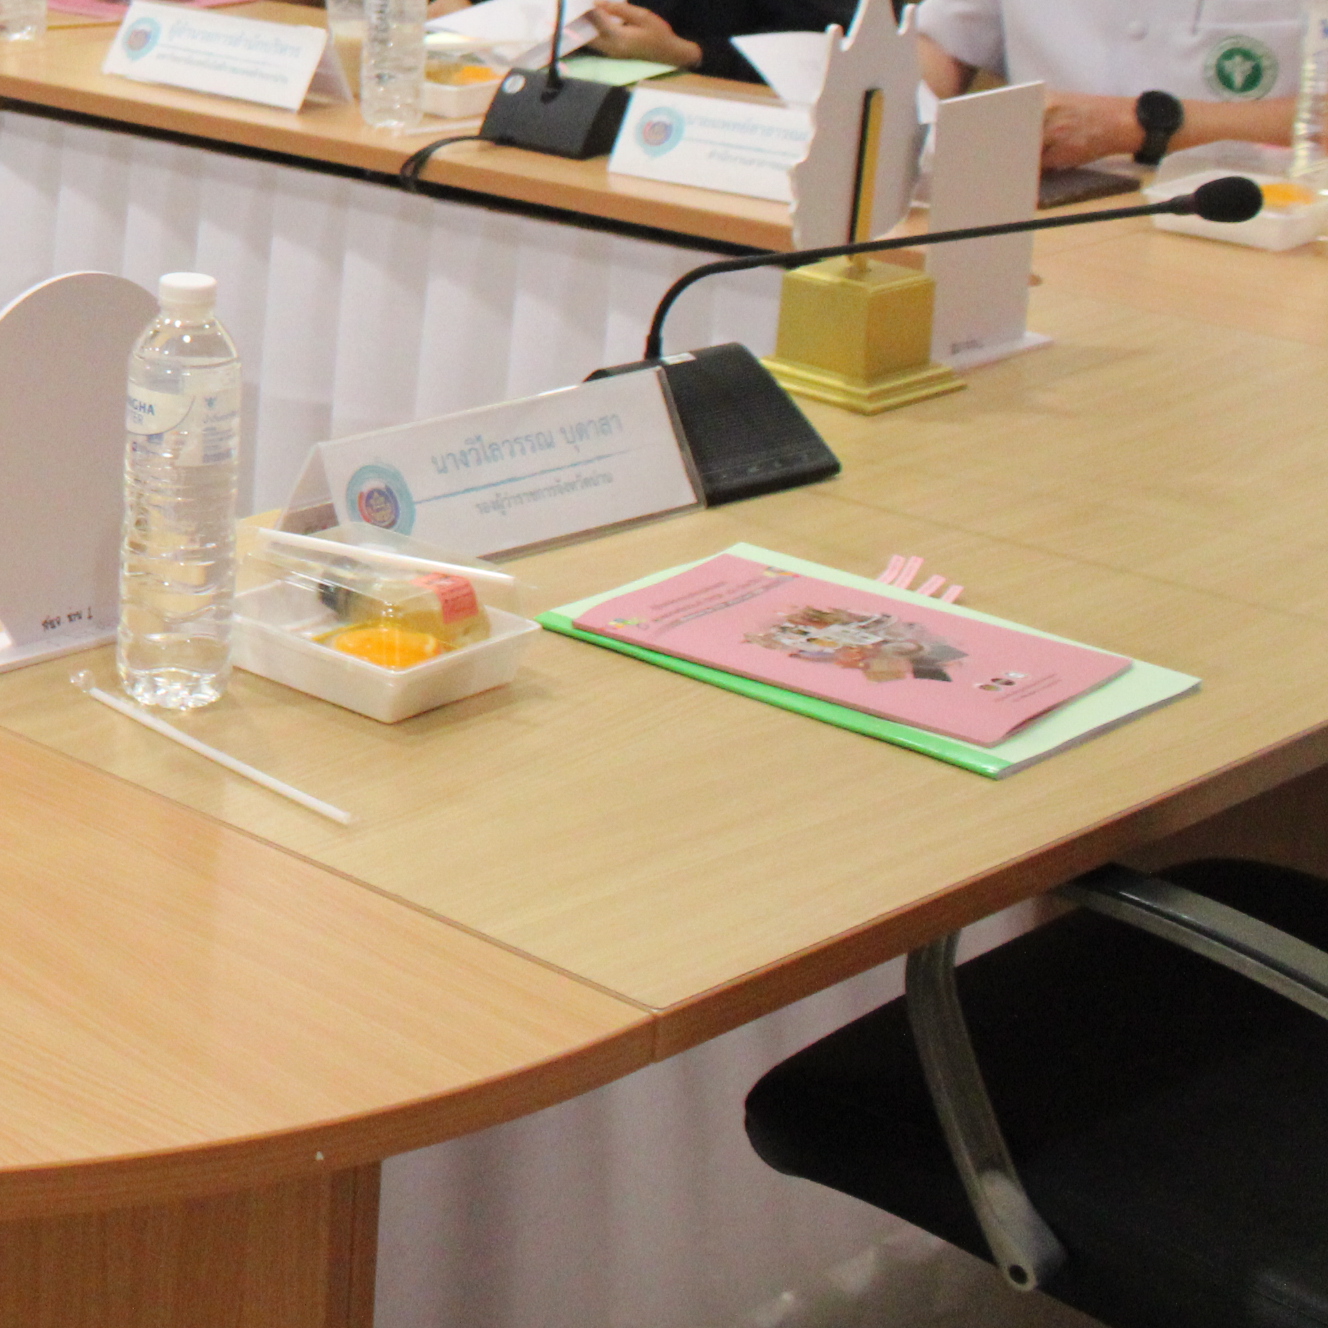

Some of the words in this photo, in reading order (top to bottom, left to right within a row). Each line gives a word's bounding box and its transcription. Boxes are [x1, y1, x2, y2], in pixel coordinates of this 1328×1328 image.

[431, 432, 555, 474] นางวิไลวรรณ
